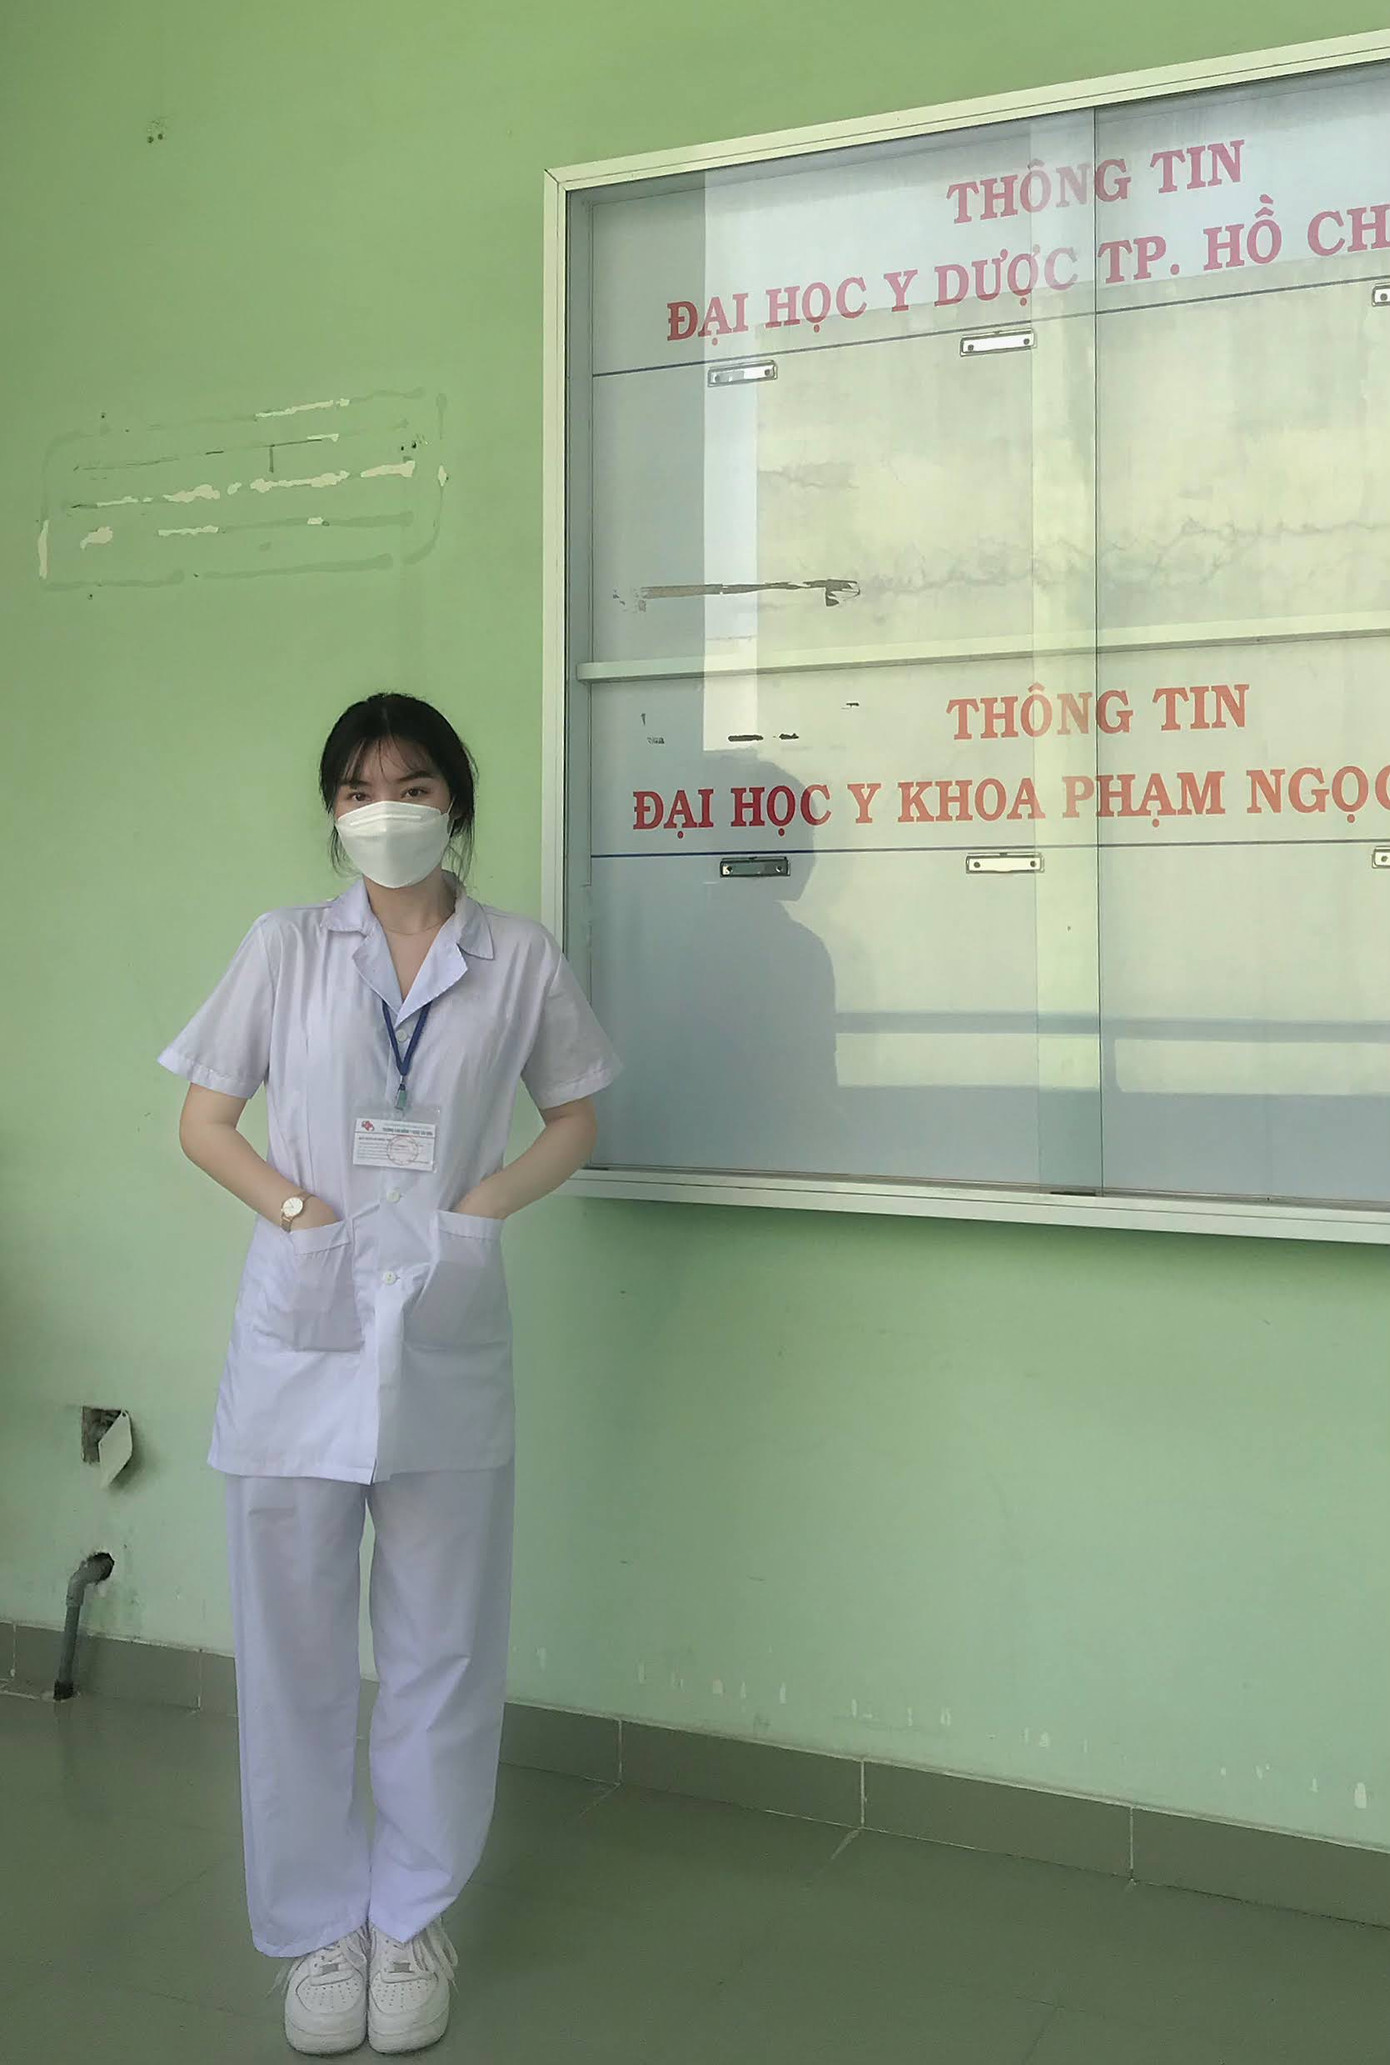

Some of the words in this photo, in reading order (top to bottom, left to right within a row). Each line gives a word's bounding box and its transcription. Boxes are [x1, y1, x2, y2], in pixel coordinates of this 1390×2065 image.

[947, 158, 1131, 224] THÔNG
[1150, 139, 1245, 193] TIN
[667, 293, 748, 345] ĐẠI
[765, 277, 867, 333] HỌC
[883, 269, 918, 312] Y
[934, 242, 1078, 307] DƯỢC
[1098, 235, 1179, 284] TP.
[1203, 194, 1282, 270] HỒ
[1307, 203, 1390, 256] CH
[947, 682, 1133, 740] THÔNG
[1153, 684, 1249, 731] TIN
[633, 789, 714, 839] ĐẠI
[730, 784, 831, 837] HỌC
[848, 783, 882, 824] Y
[897, 777, 1046, 822] KHOA
[1062, 771, 1226, 828] PHẠM
